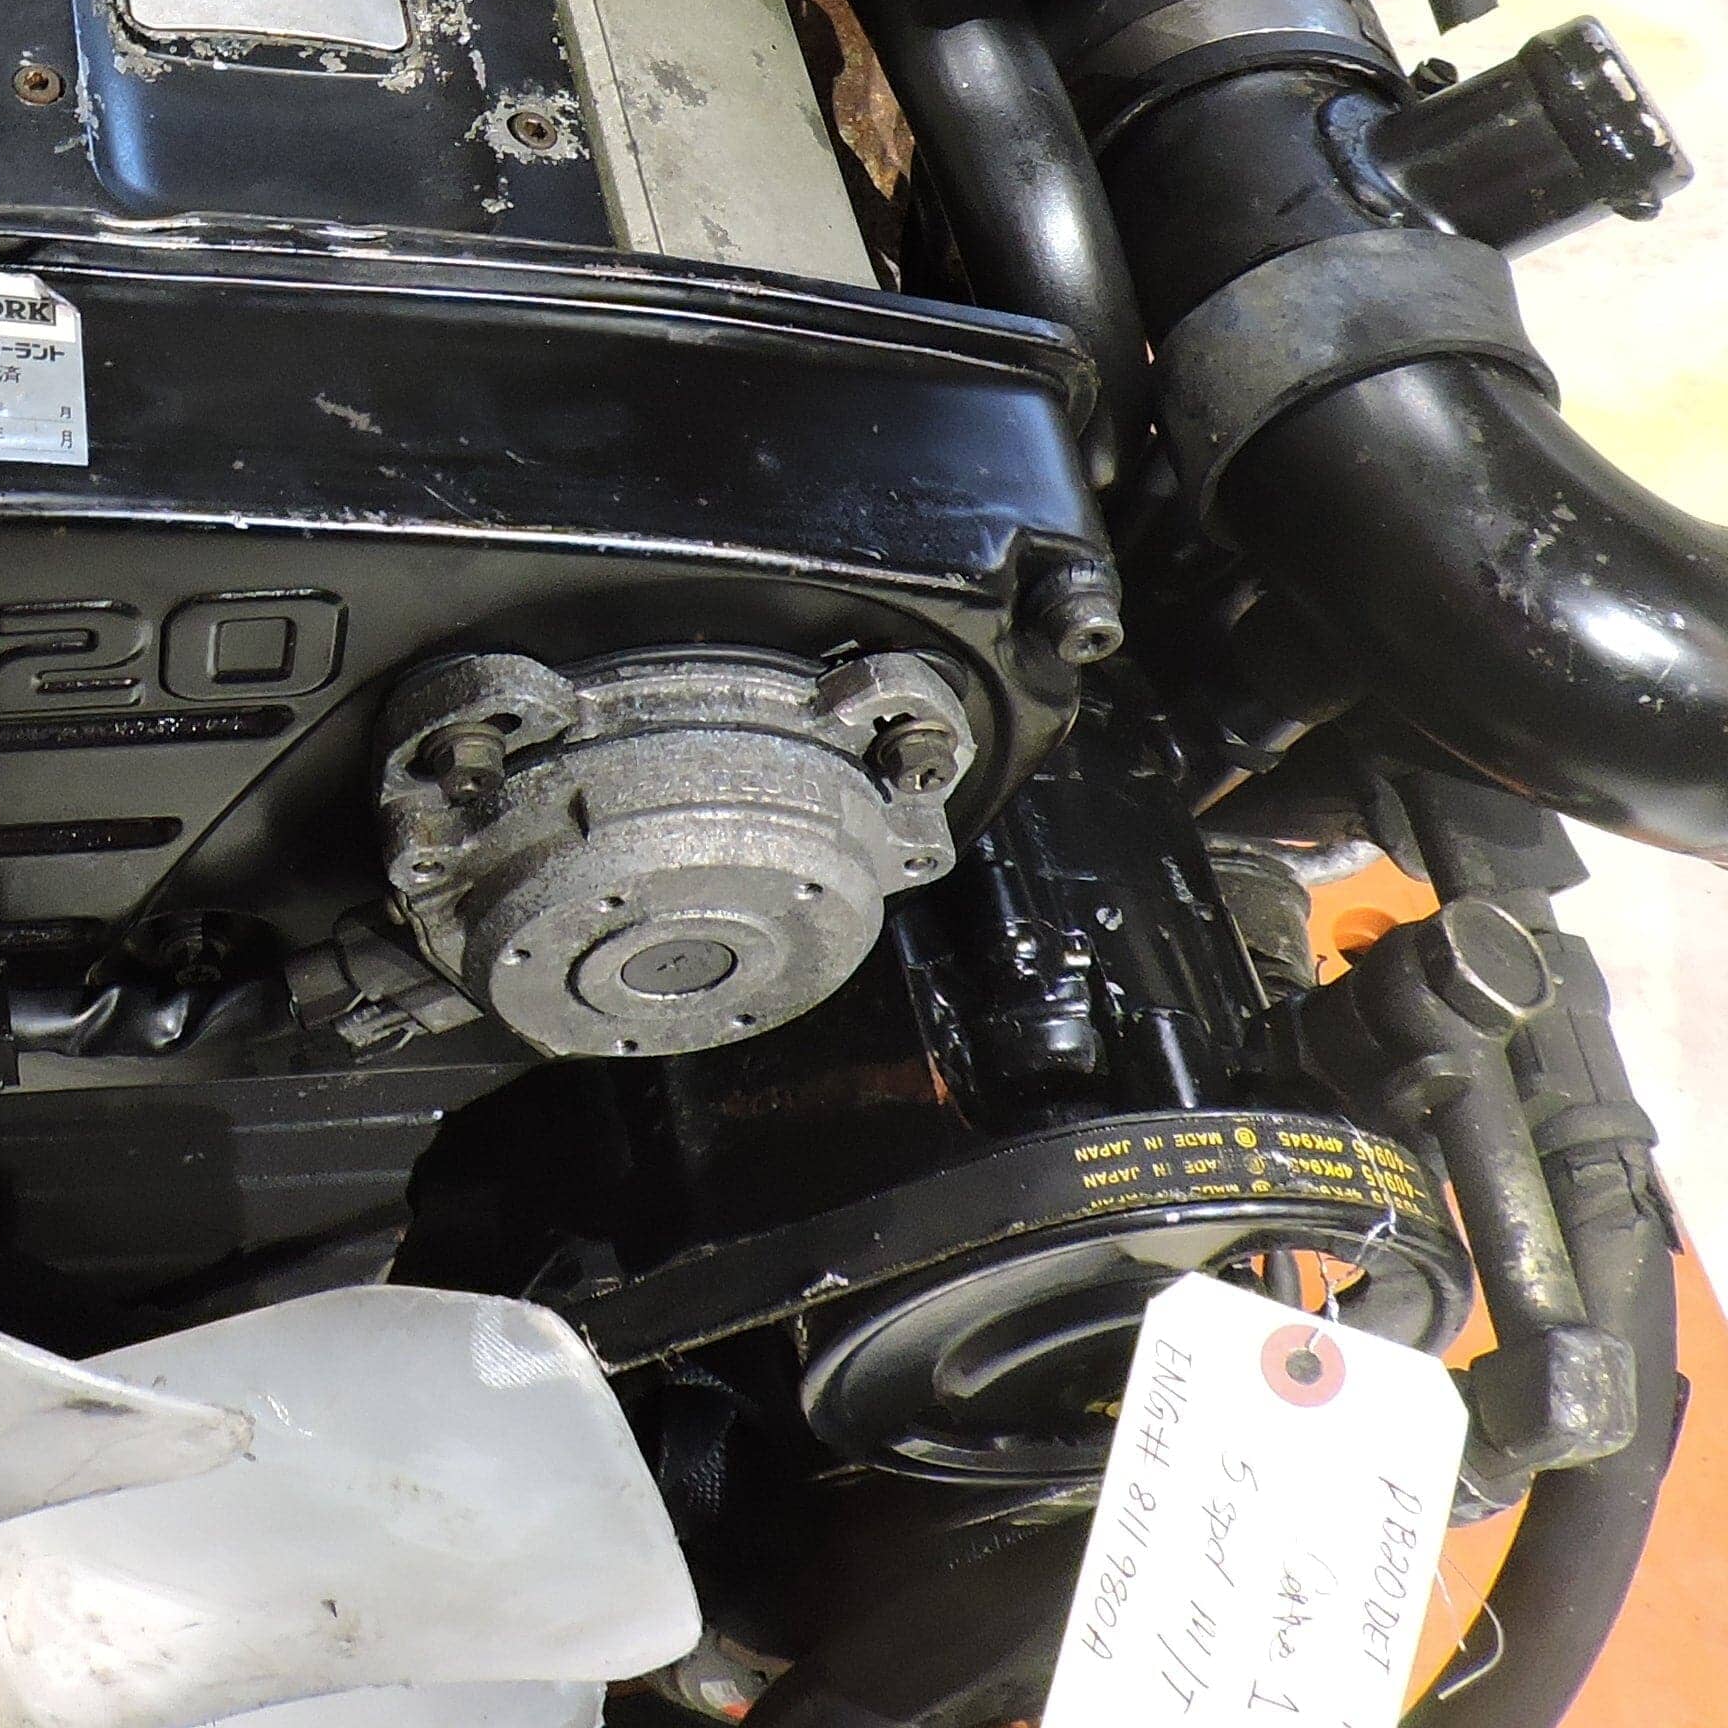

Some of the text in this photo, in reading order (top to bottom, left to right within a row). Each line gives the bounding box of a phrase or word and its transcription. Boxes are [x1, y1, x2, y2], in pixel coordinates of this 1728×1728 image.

[1143, 1135, 1164, 1151] IN
[1173, 1131, 1223, 1148] MADE
[1279, 1131, 1344, 1153] 4PK945
[1075, 1138, 1133, 1162] JAPAN
[1083, 1166, 1142, 1189] JAPAN
[1152, 1162, 1172, 1178] IN
